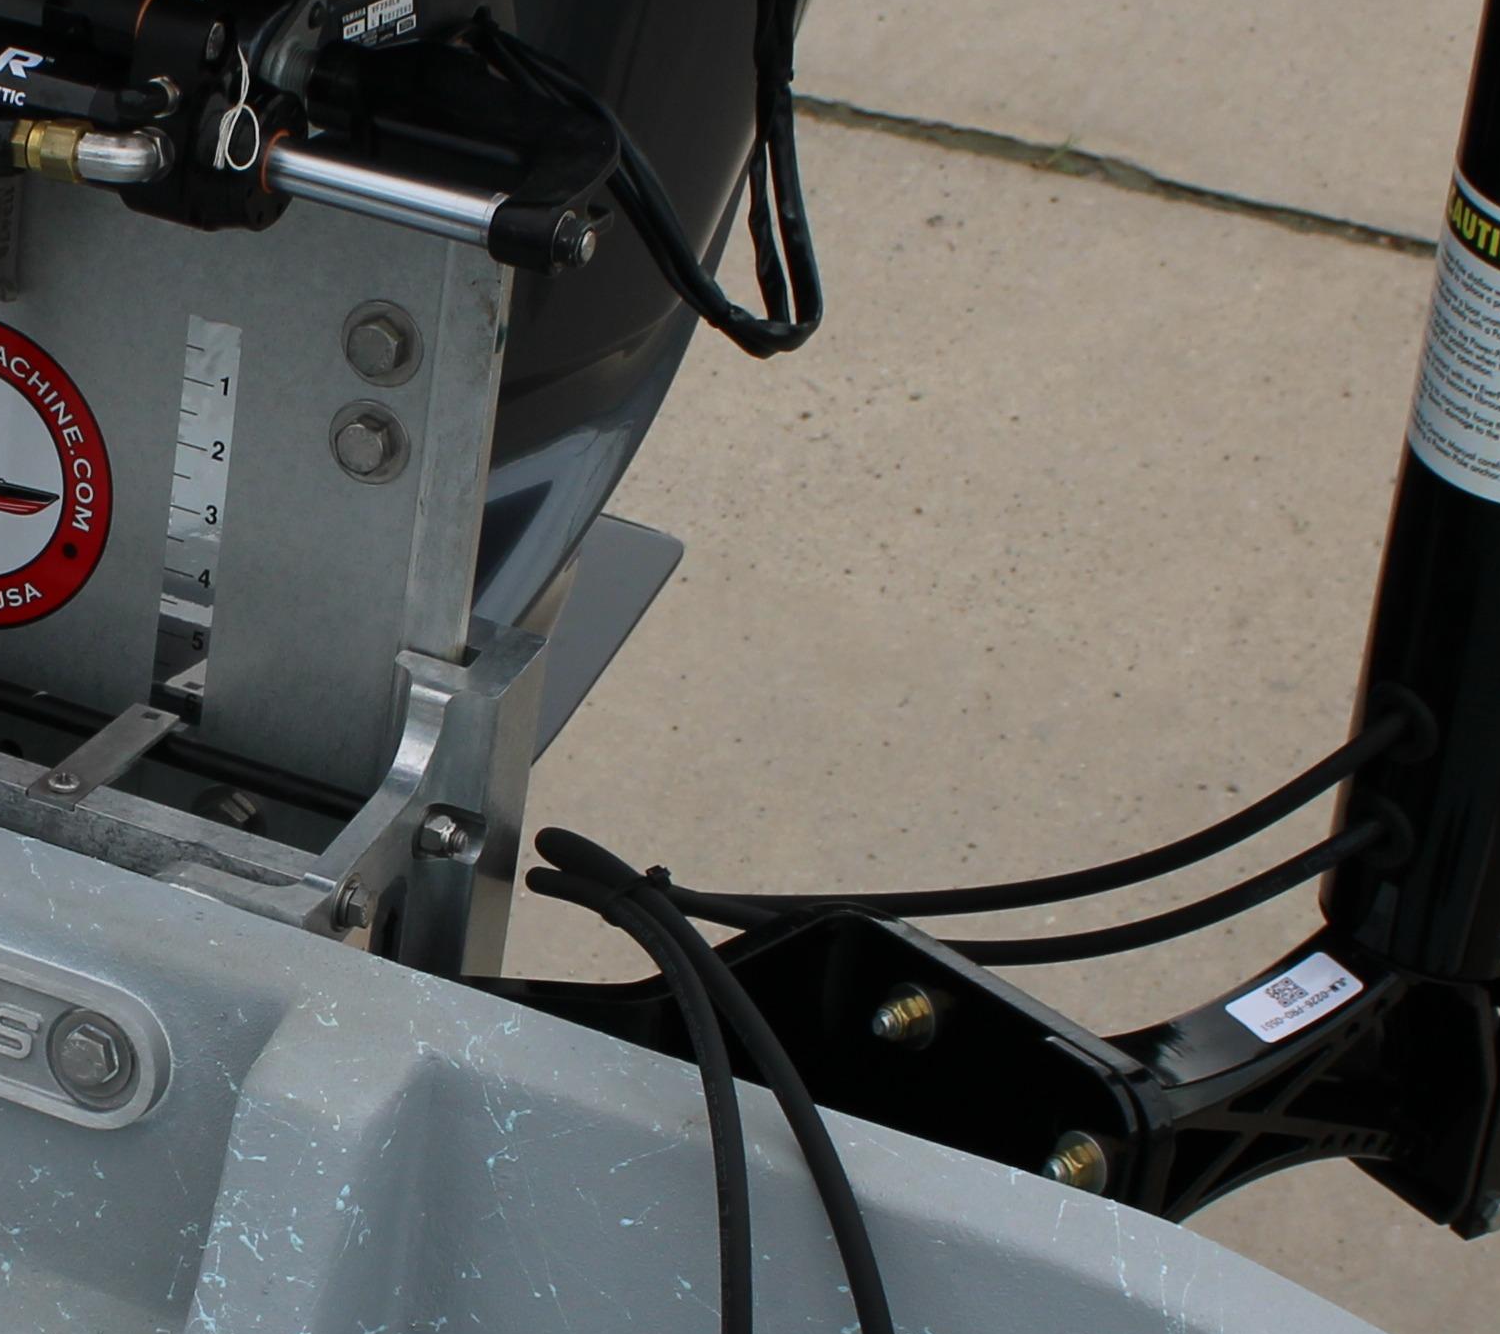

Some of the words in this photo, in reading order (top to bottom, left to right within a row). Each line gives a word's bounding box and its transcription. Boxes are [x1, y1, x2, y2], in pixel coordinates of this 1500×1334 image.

[220, 376, 230, 396] 1
[211, 441, 225, 461] 2
[205, 505, 218, 525] 3
[198, 569, 211, 589] 4
[191, 631, 204, 651] 5
